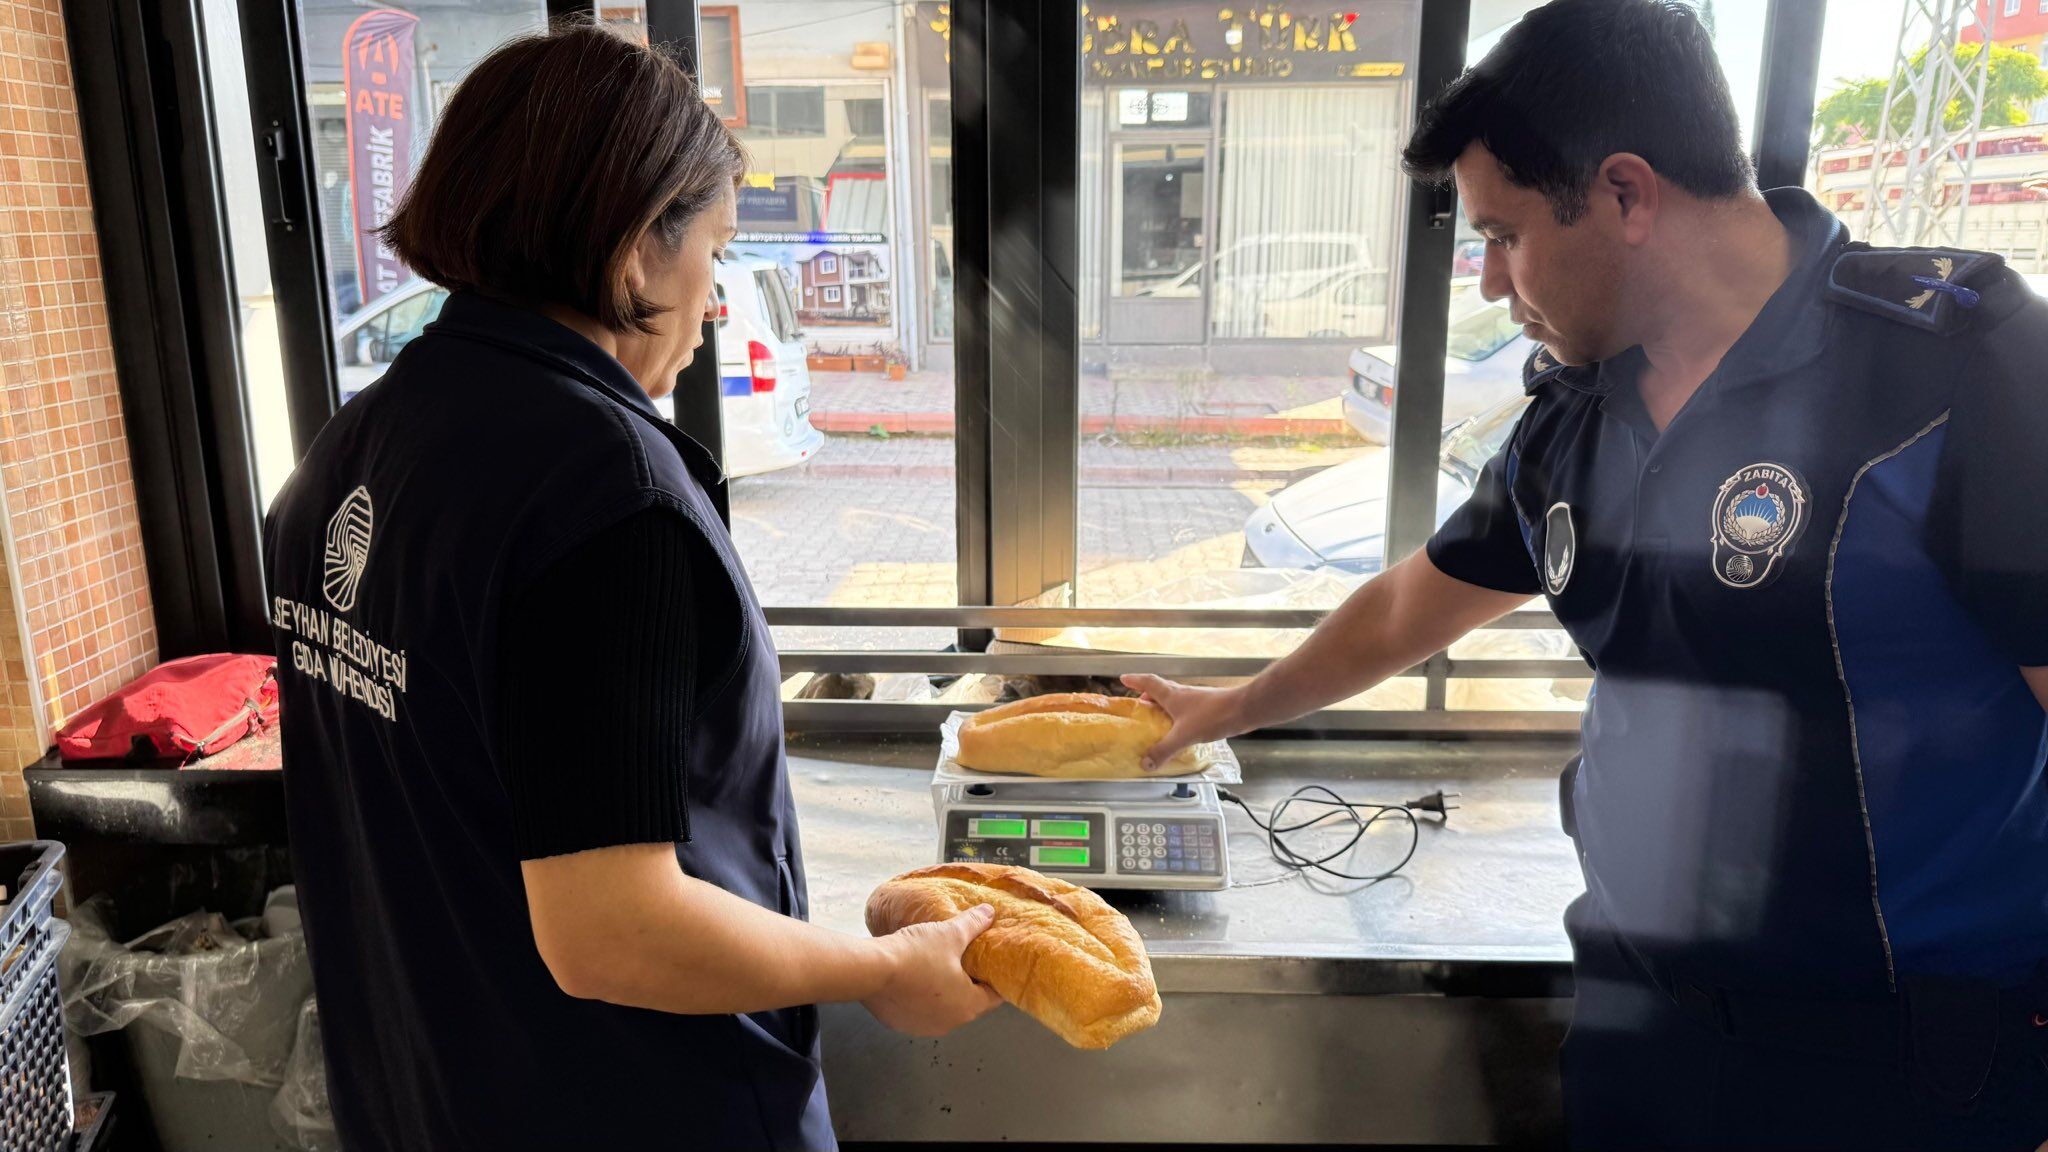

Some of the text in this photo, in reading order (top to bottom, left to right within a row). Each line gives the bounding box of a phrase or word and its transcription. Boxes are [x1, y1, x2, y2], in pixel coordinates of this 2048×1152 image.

[355, 88, 404, 120] ATE
[1743, 469, 1789, 488] ZABITA
[273, 596, 407, 693] SEYHAN BELEDİYESİ
[292, 641, 328, 681] GIDA
